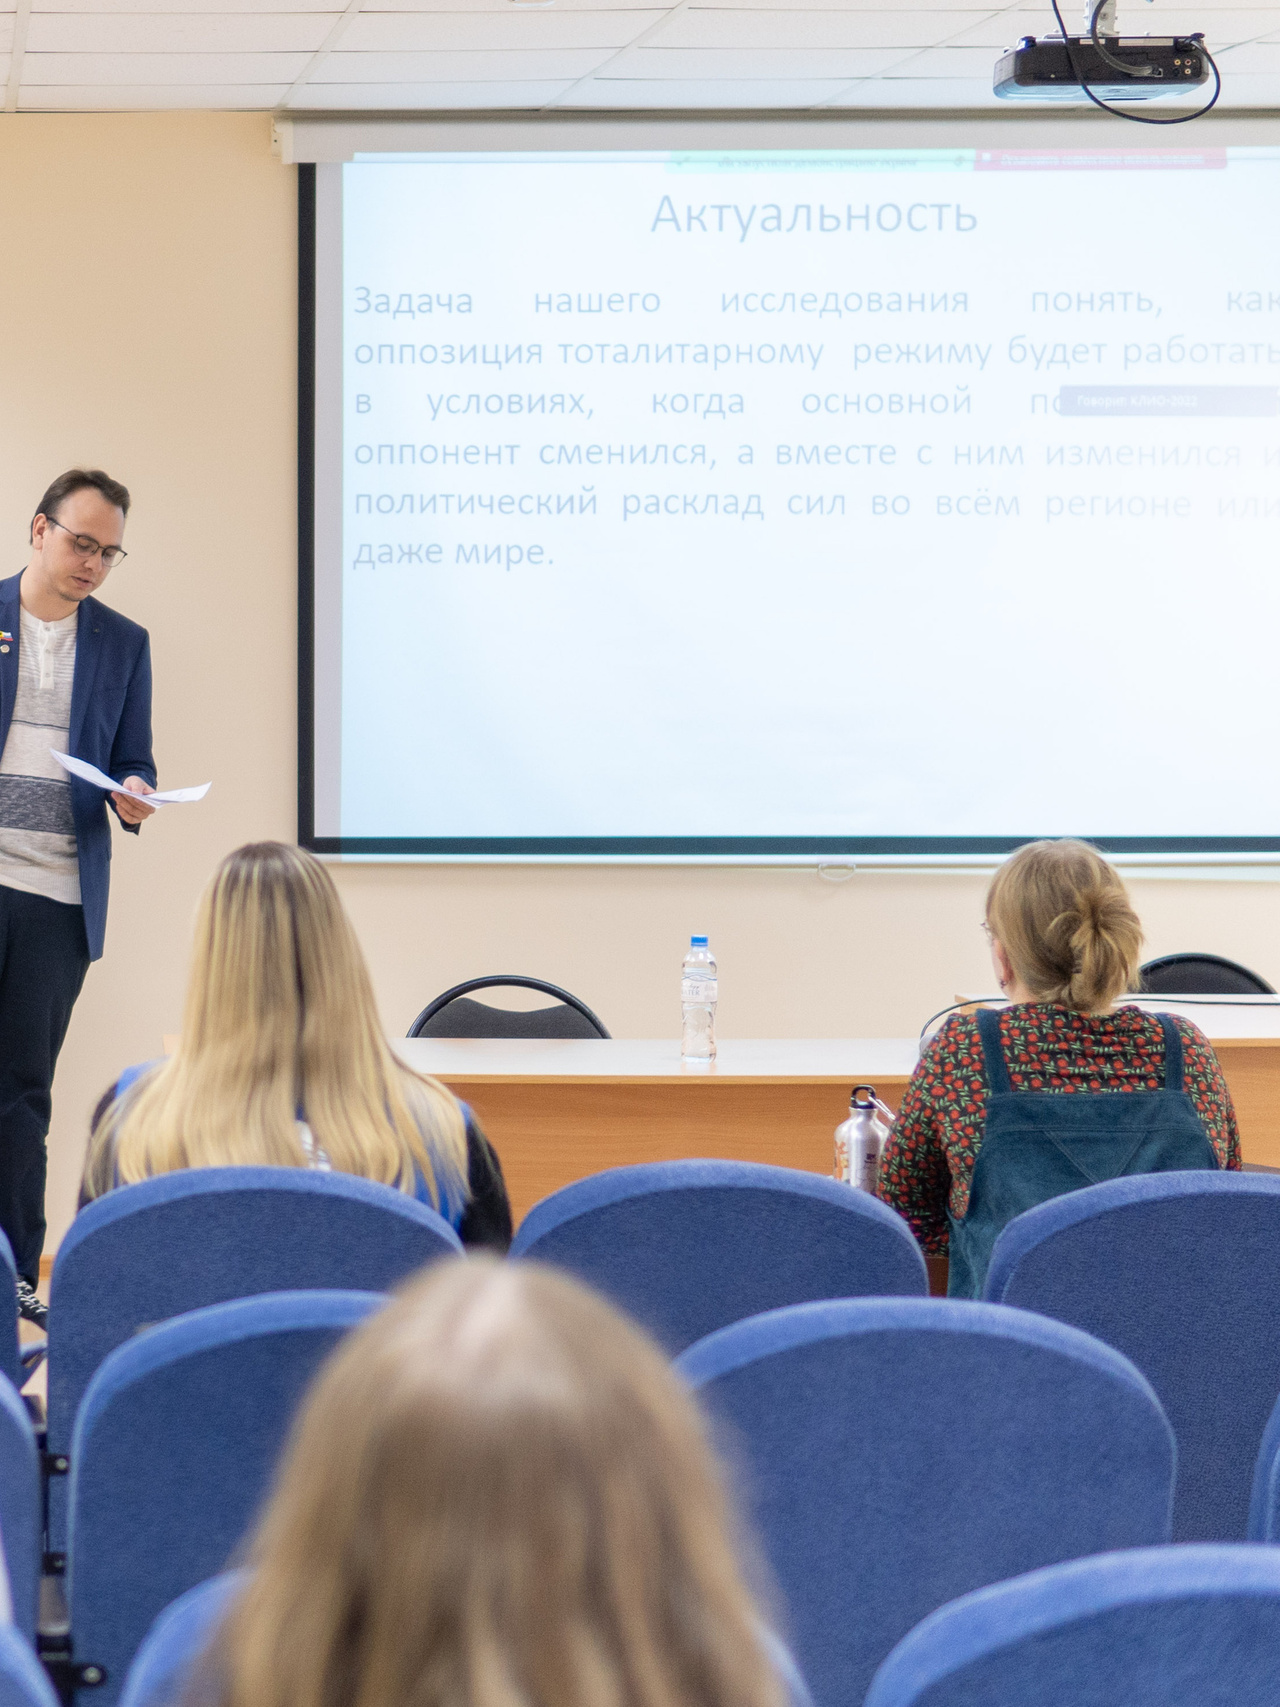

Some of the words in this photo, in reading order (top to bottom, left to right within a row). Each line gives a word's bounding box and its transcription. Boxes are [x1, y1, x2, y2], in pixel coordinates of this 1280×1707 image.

[650, 195, 977, 243] Актуальность
[354, 286, 472, 320] Задача
[535, 292, 661, 313] нашего
[721, 292, 968, 319] исследования
[1032, 291, 1162, 318] понять,
[1227, 291, 1280, 312] как
[354, 344, 542, 371] оппозиция
[558, 343, 824, 371] тоталитарному
[854, 343, 992, 371] режиму
[1008, 334, 1107, 371] будет
[1123, 334, 1280, 371] работать
[356, 393, 372, 414] в
[427, 393, 593, 421] условиях,
[652, 393, 744, 420] когда
[801, 385, 971, 414] основной
[354, 444, 521, 465] оппонент
[539, 444, 716, 470] сменился,
[737, 444, 754, 465] а
[776, 444, 896, 465] вместе
[917, 444, 932, 466] с
[954, 445, 1024, 465] ним
[1045, 445, 1240, 466] изменился
[356, 485, 597, 515] политический
[623, 494, 764, 522] расклад
[787, 494, 845, 515] сил
[872, 495, 910, 516] во
[936, 488, 1020, 516] всём
[1046, 495, 1191, 524] регионе
[353, 543, 443, 570] даже
[455, 543, 553, 572] мире.
